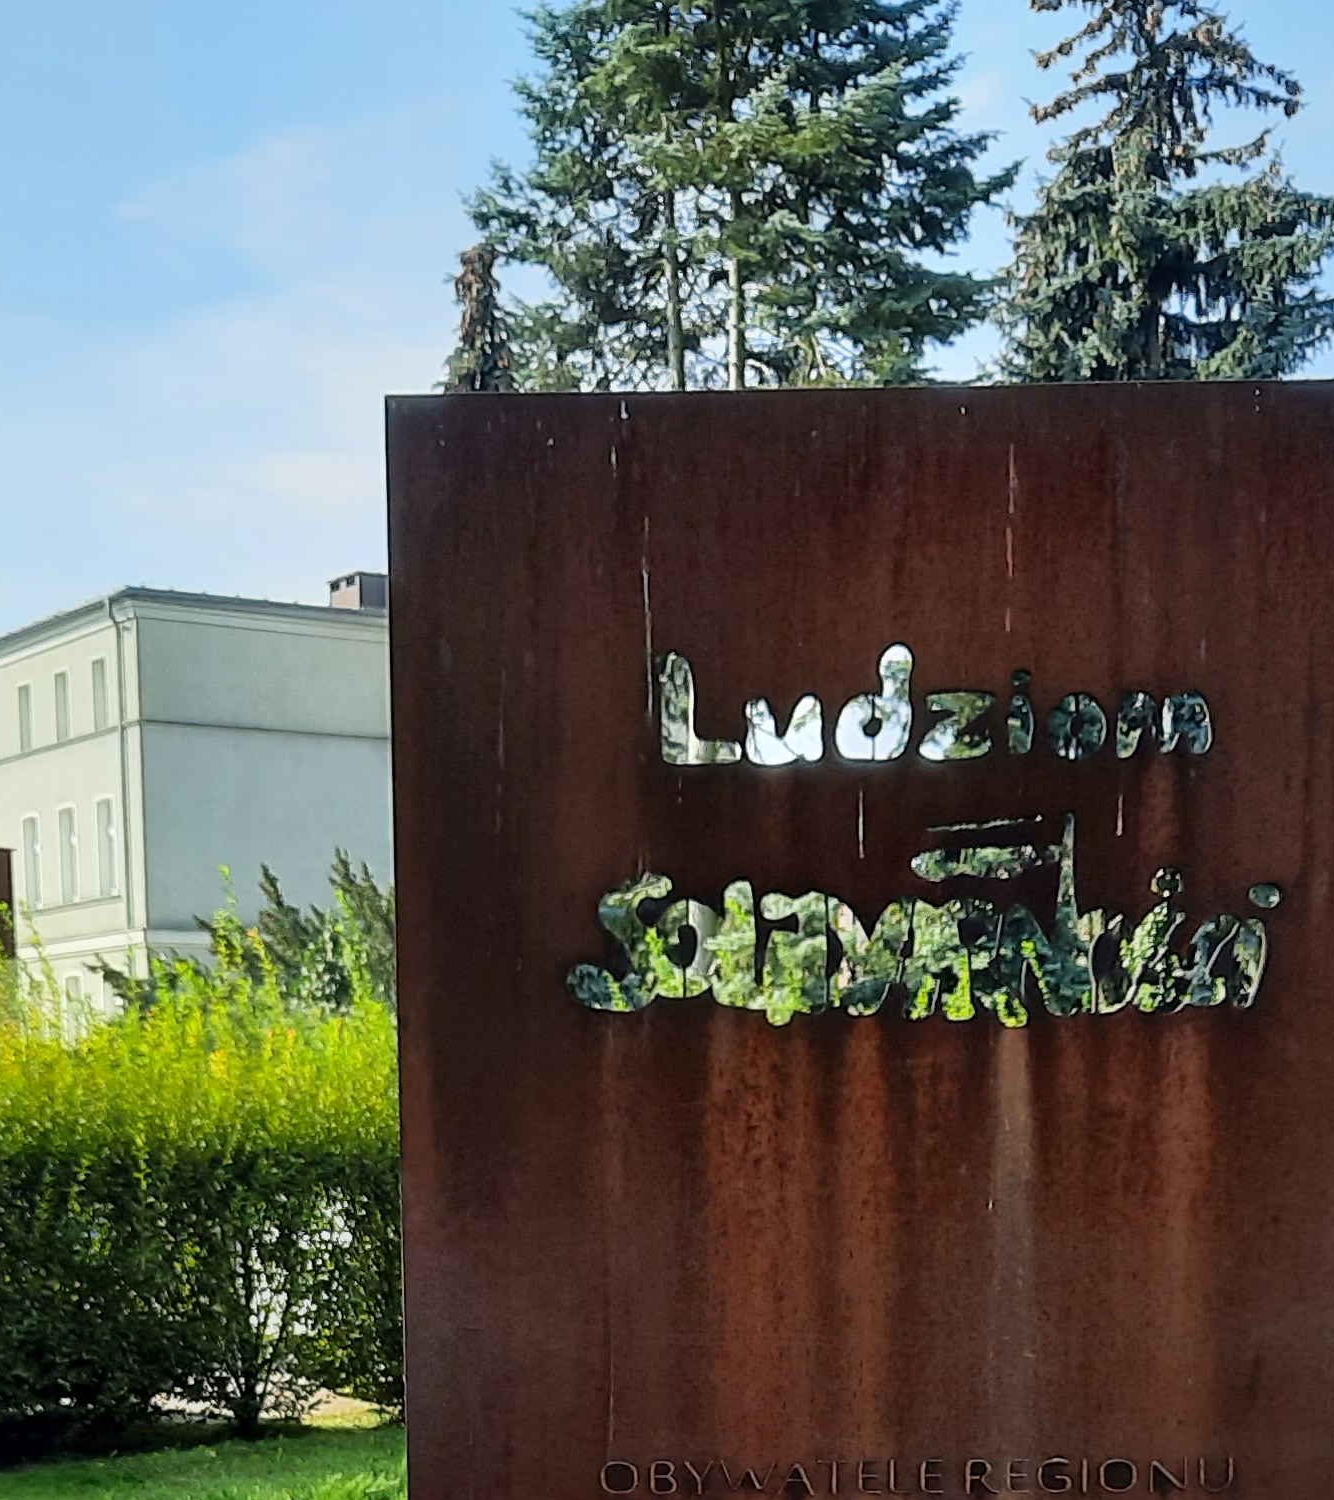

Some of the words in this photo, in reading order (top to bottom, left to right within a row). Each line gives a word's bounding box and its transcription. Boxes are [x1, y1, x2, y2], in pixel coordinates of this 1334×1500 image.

[657, 642, 1213, 764] Ludziom
[599, 1459, 944, 1496] OBYWATELE
[965, 1458, 1236, 1495] REGIONU
